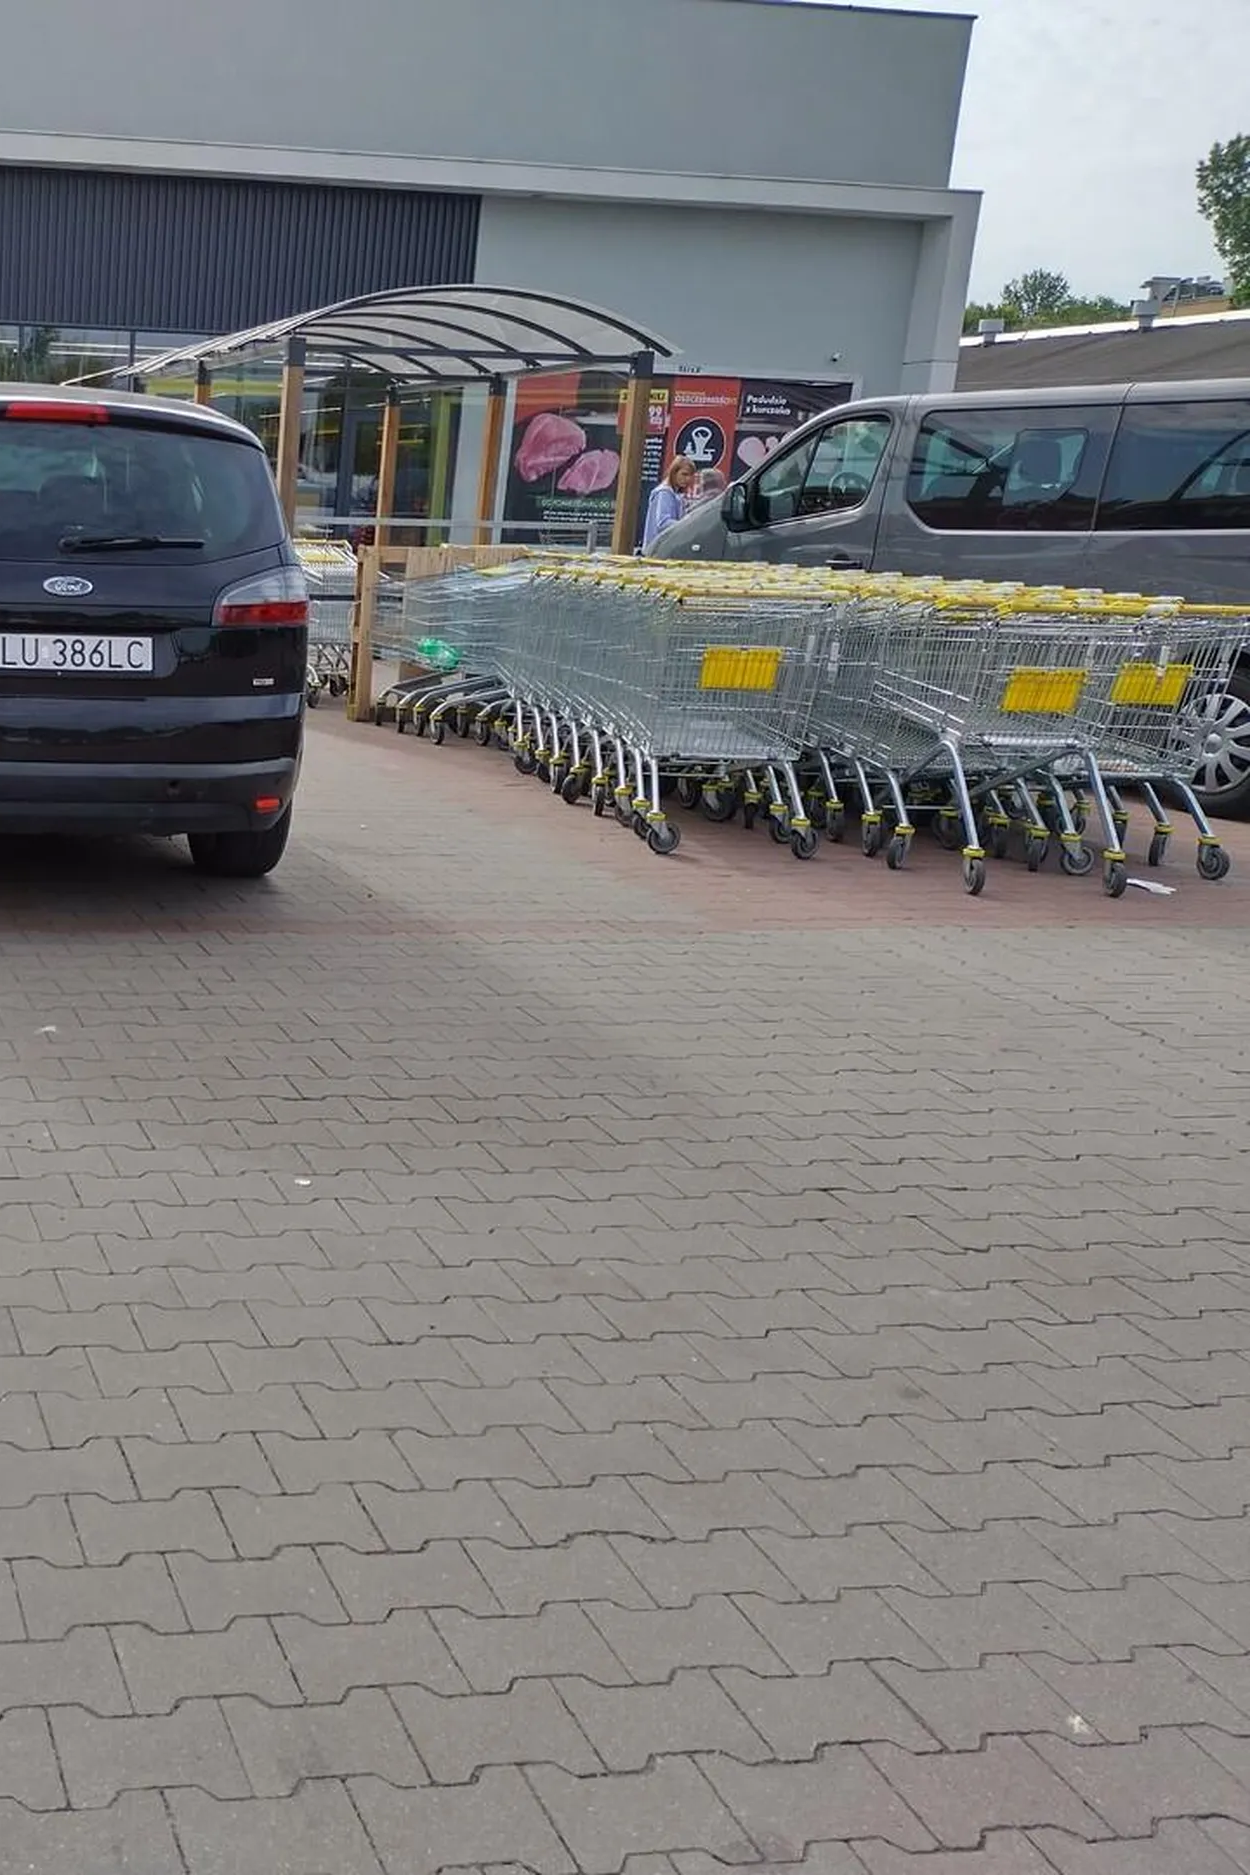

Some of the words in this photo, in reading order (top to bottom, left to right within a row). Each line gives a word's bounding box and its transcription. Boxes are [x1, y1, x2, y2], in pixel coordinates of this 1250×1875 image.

[53, 579, 83, 592] Ford
[2, 636, 39, 666] LU
[52, 638, 144, 669] 386LC
